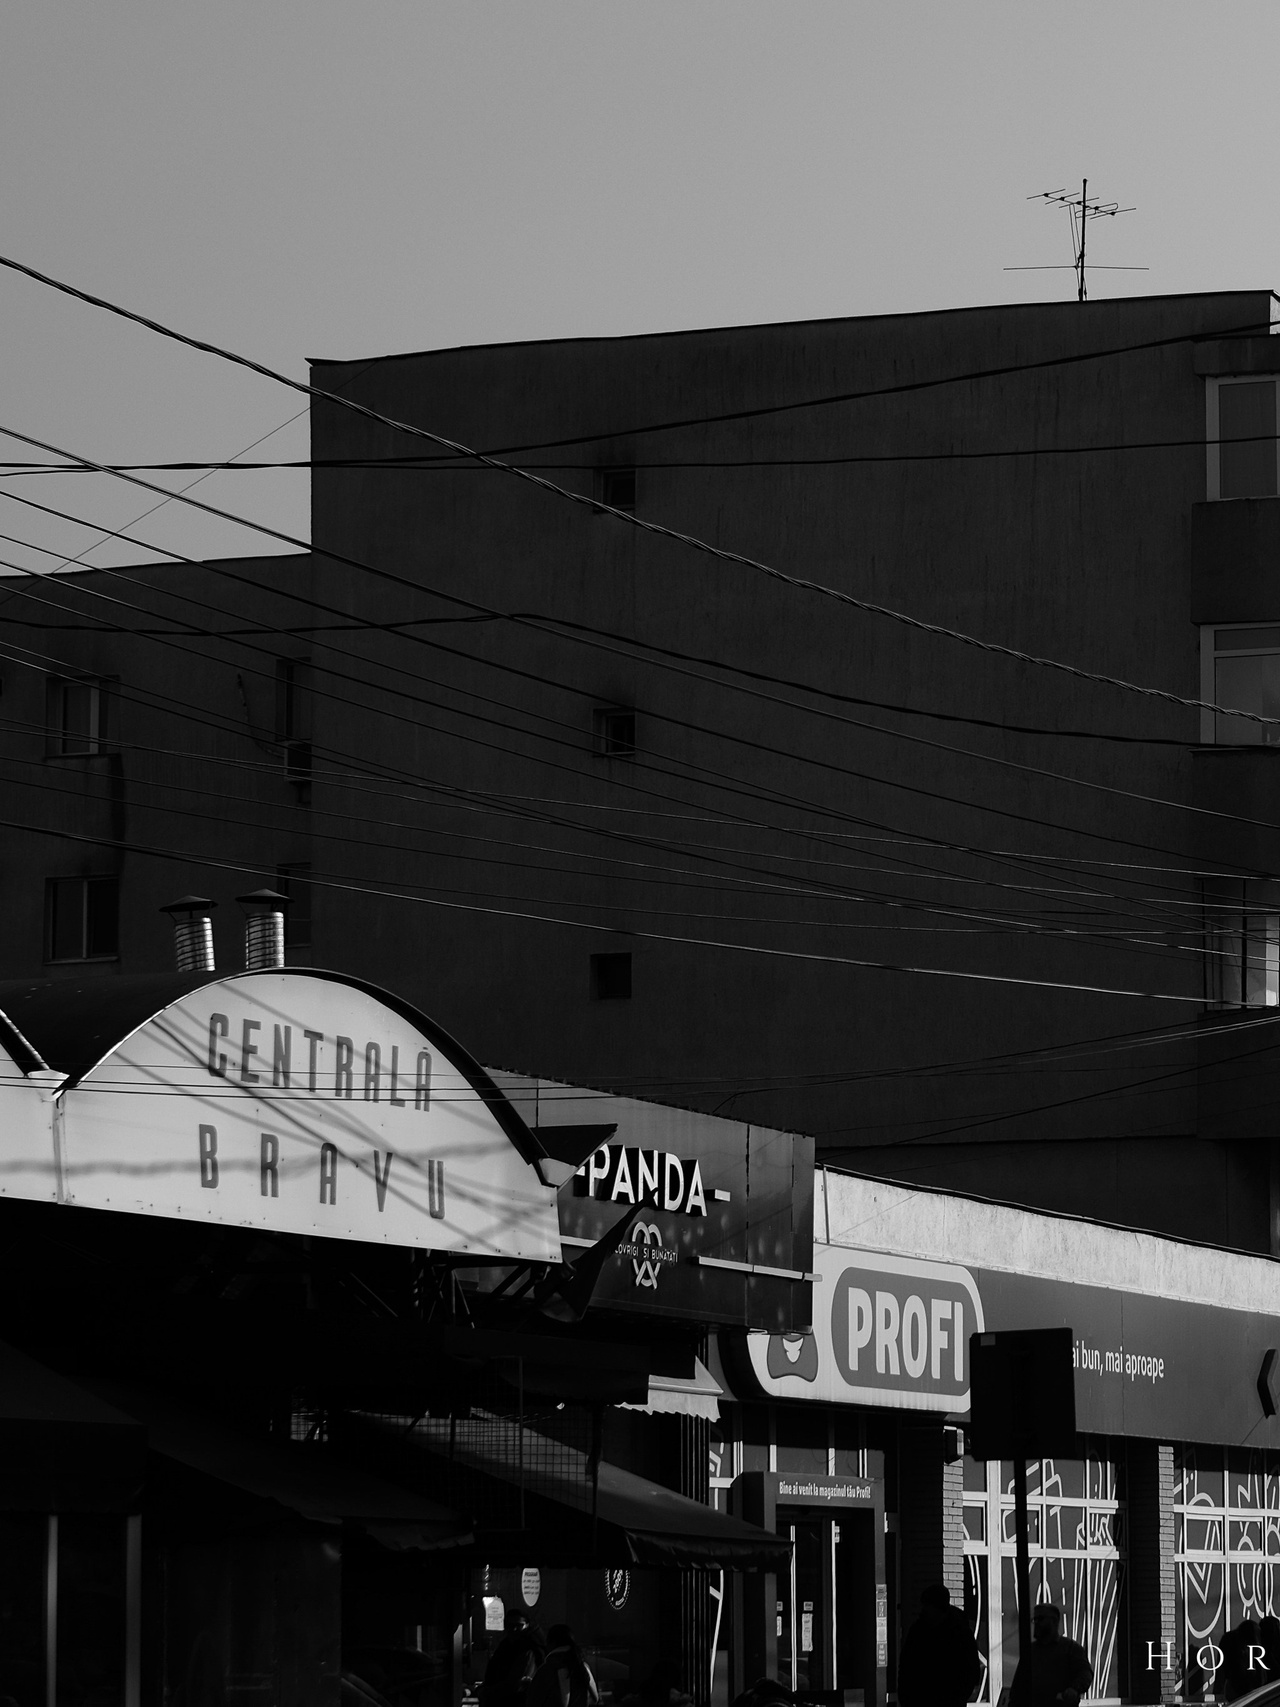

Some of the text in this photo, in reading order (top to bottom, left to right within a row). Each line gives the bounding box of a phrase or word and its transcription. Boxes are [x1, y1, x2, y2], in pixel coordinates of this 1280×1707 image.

[199, 1123, 446, 1220] BRAVU
[848, 1286, 964, 1382] PROFI
[1081, 1340, 1104, 1377] bun,
[1105, 1345, 1123, 1374] mai
[1125, 1353, 1165, 1385] aproape
[779, 1480, 793, 1495] Bine
[793, 1481, 799, 1495] ai
[799, 1482, 813, 1496] venit
[813, 1483, 819, 1496] la
[819, 1484, 847, 1500] magazinul
